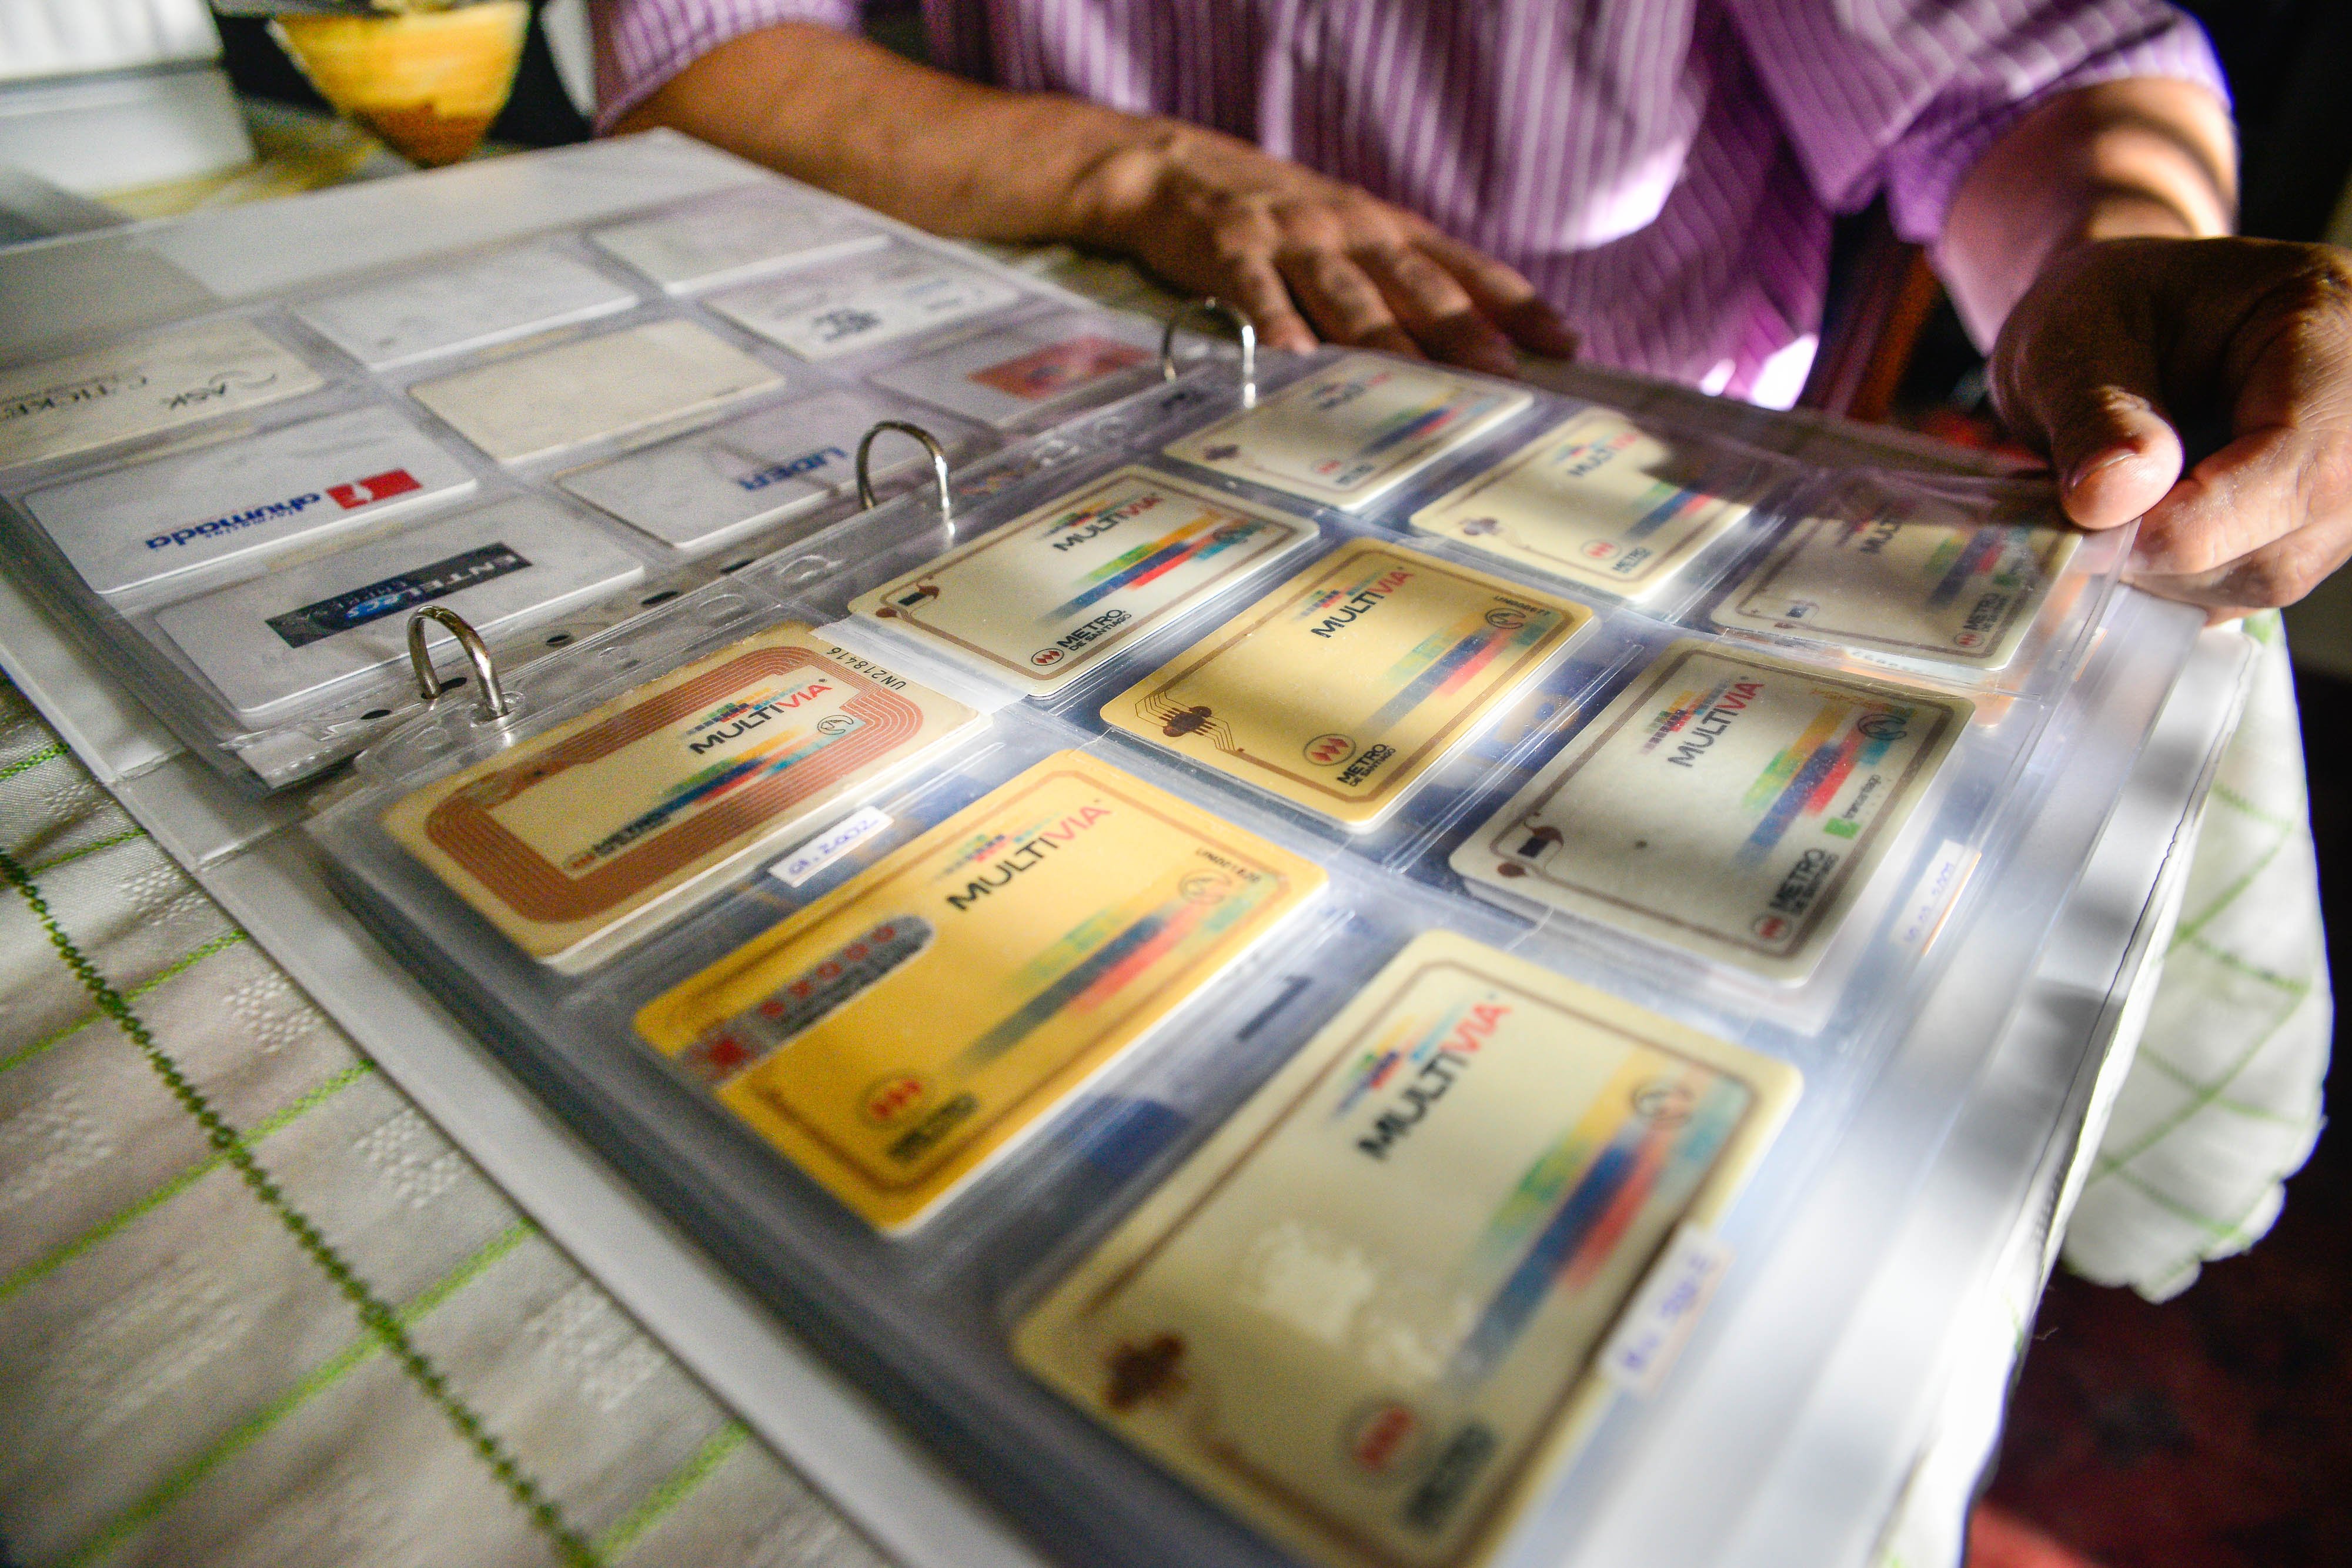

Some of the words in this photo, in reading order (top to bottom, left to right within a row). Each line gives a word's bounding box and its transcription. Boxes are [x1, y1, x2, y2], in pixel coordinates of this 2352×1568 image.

[145, 493, 321, 548] ahumada
[1057, 609, 1123, 648] METRO
[1068, 640, 1087, 651] DE
[1085, 613, 1132, 643] SANTIAGO
[1311, 571, 1415, 638] MULTIVIA
[826, 647, 907, 690] UN218416
[689, 684, 833, 755] MULTIVIA
[1668, 682, 1764, 768] MULTIVIA
[1337, 744, 1387, 784] METRO
[946, 805, 1112, 912] MULTIVIA
[1357, 1002, 1515, 1163] MULTIVIA
